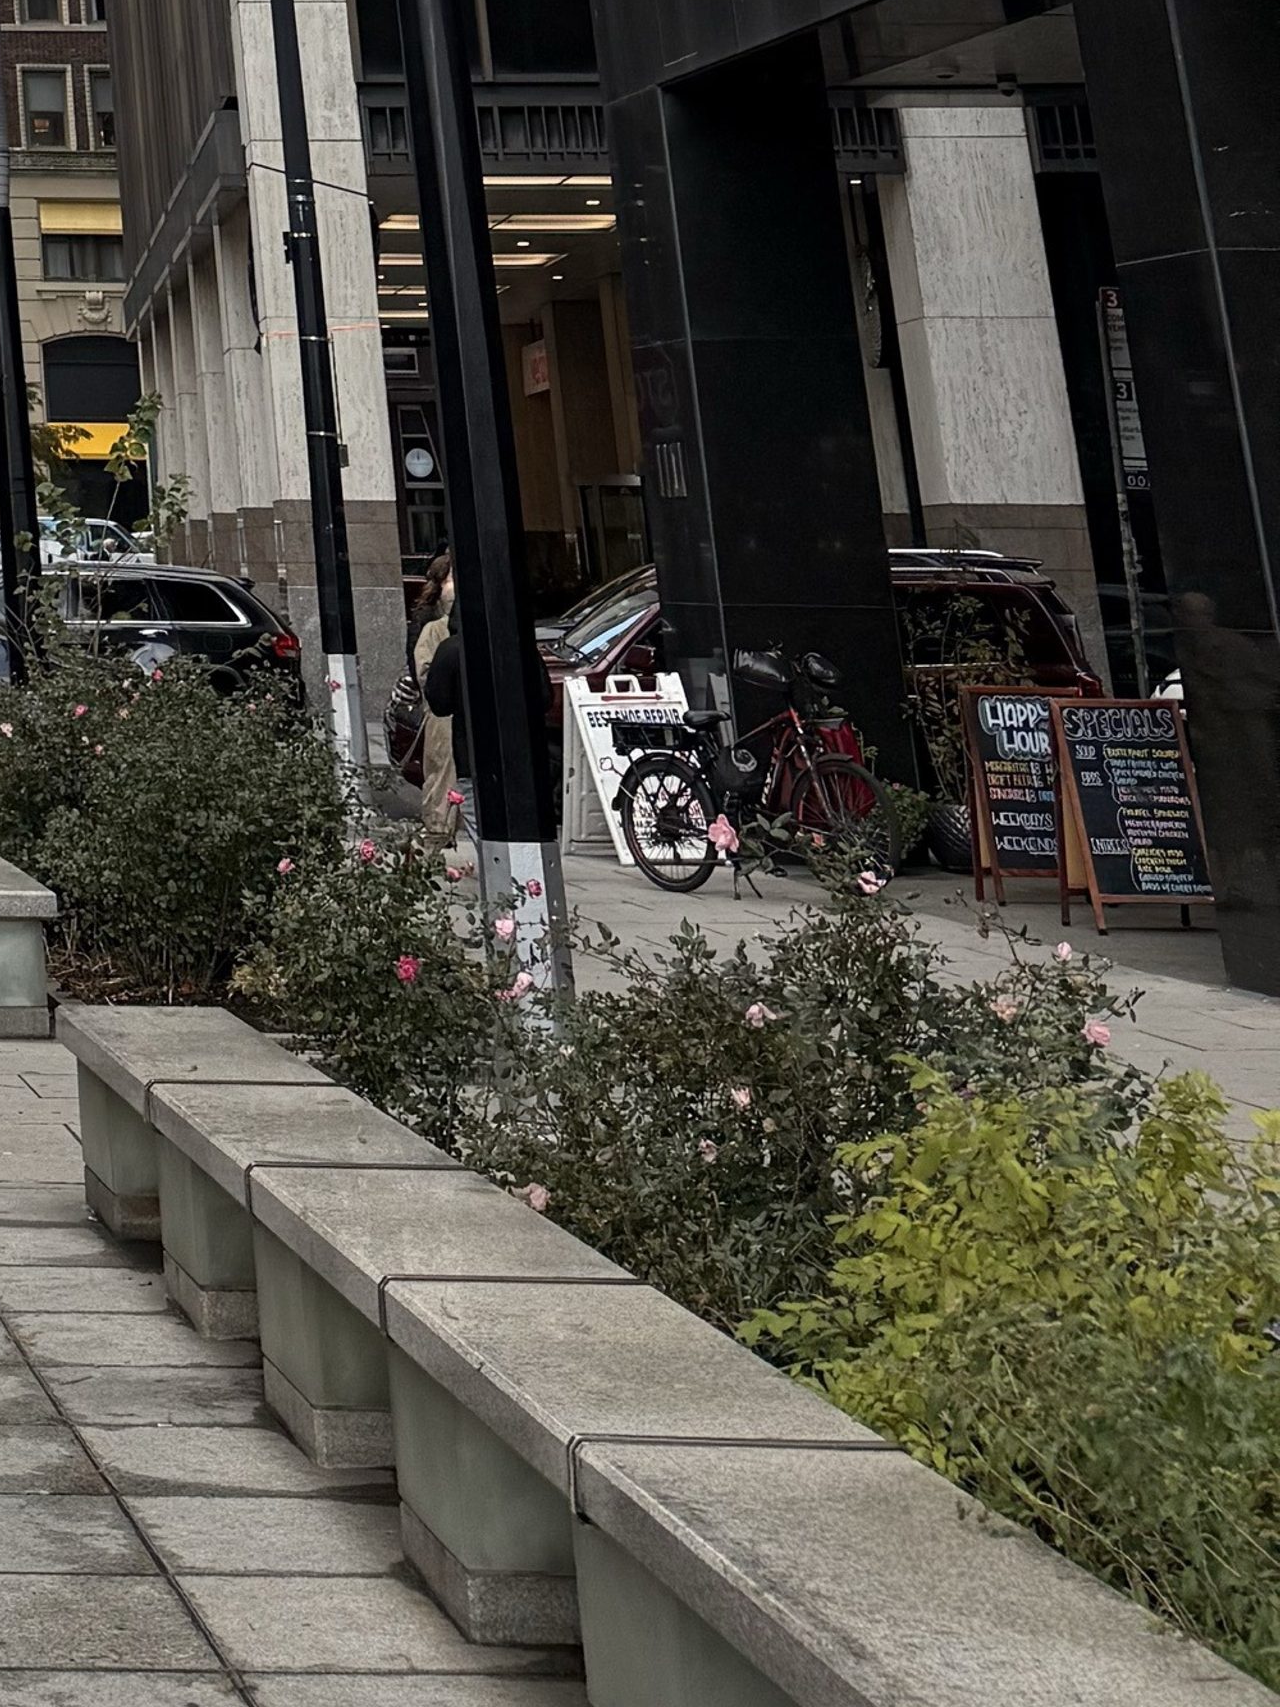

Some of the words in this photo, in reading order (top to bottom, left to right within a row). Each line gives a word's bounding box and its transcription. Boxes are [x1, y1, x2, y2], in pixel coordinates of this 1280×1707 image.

[588, 712, 611, 728] BEST
[645, 708, 680, 725] REPAIR
[986, 700, 1050, 730] HAPPY
[1062, 707, 1176, 738] SPECIALS
[1003, 730, 1052, 756] HOUR
